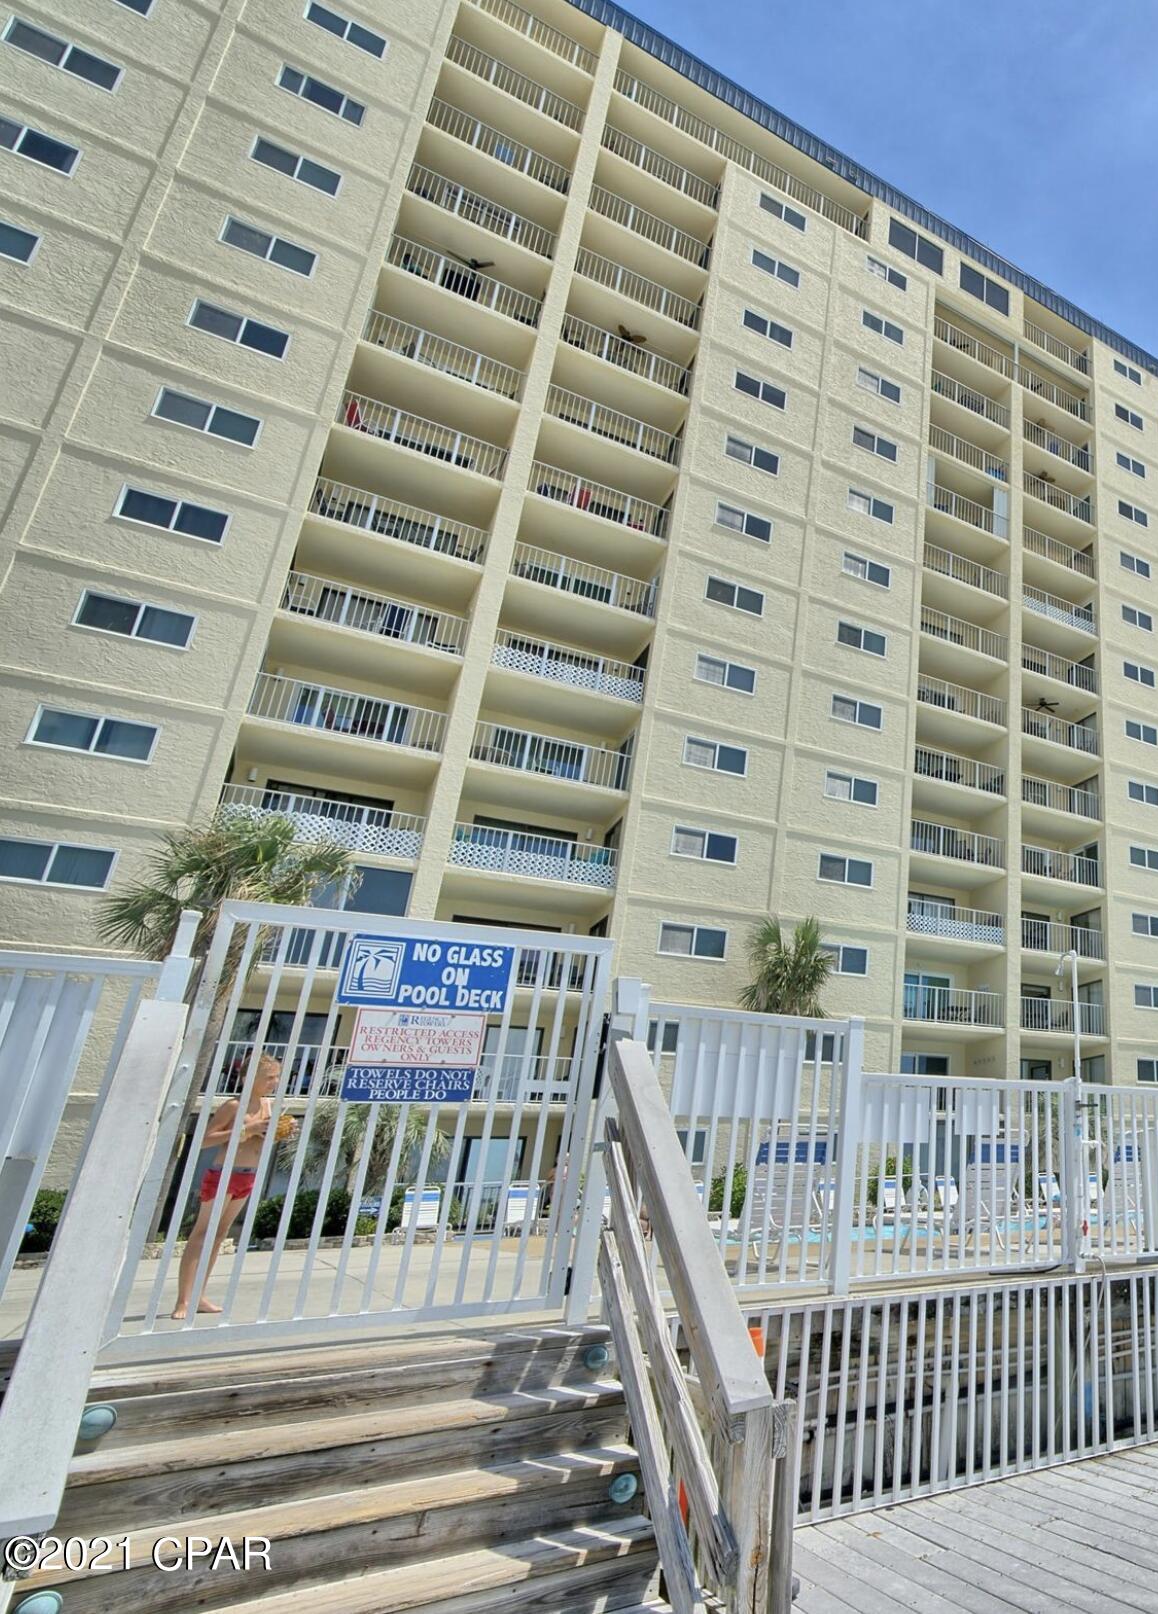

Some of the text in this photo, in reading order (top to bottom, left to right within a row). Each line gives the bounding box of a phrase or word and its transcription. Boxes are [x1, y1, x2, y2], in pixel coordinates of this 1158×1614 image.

[412, 942, 504, 968] NO GLASS
[441, 966, 470, 986] ON
[397, 984, 504, 1009] POOL DECK
[359, 1026, 480, 1039] RESTRICTED ACCESS
[364, 1035, 472, 1046] REGENCY TOWERS
[361, 1043, 472, 1055] OWNERS & GUESTS
[400, 1053, 431, 1062] ONLY
[350, 1068, 471, 1081] TOWELS DO NOT
[347, 1078, 470, 1091] RESERVE CHAIRS
[368, 1089, 447, 1100] PEOPLE DO
